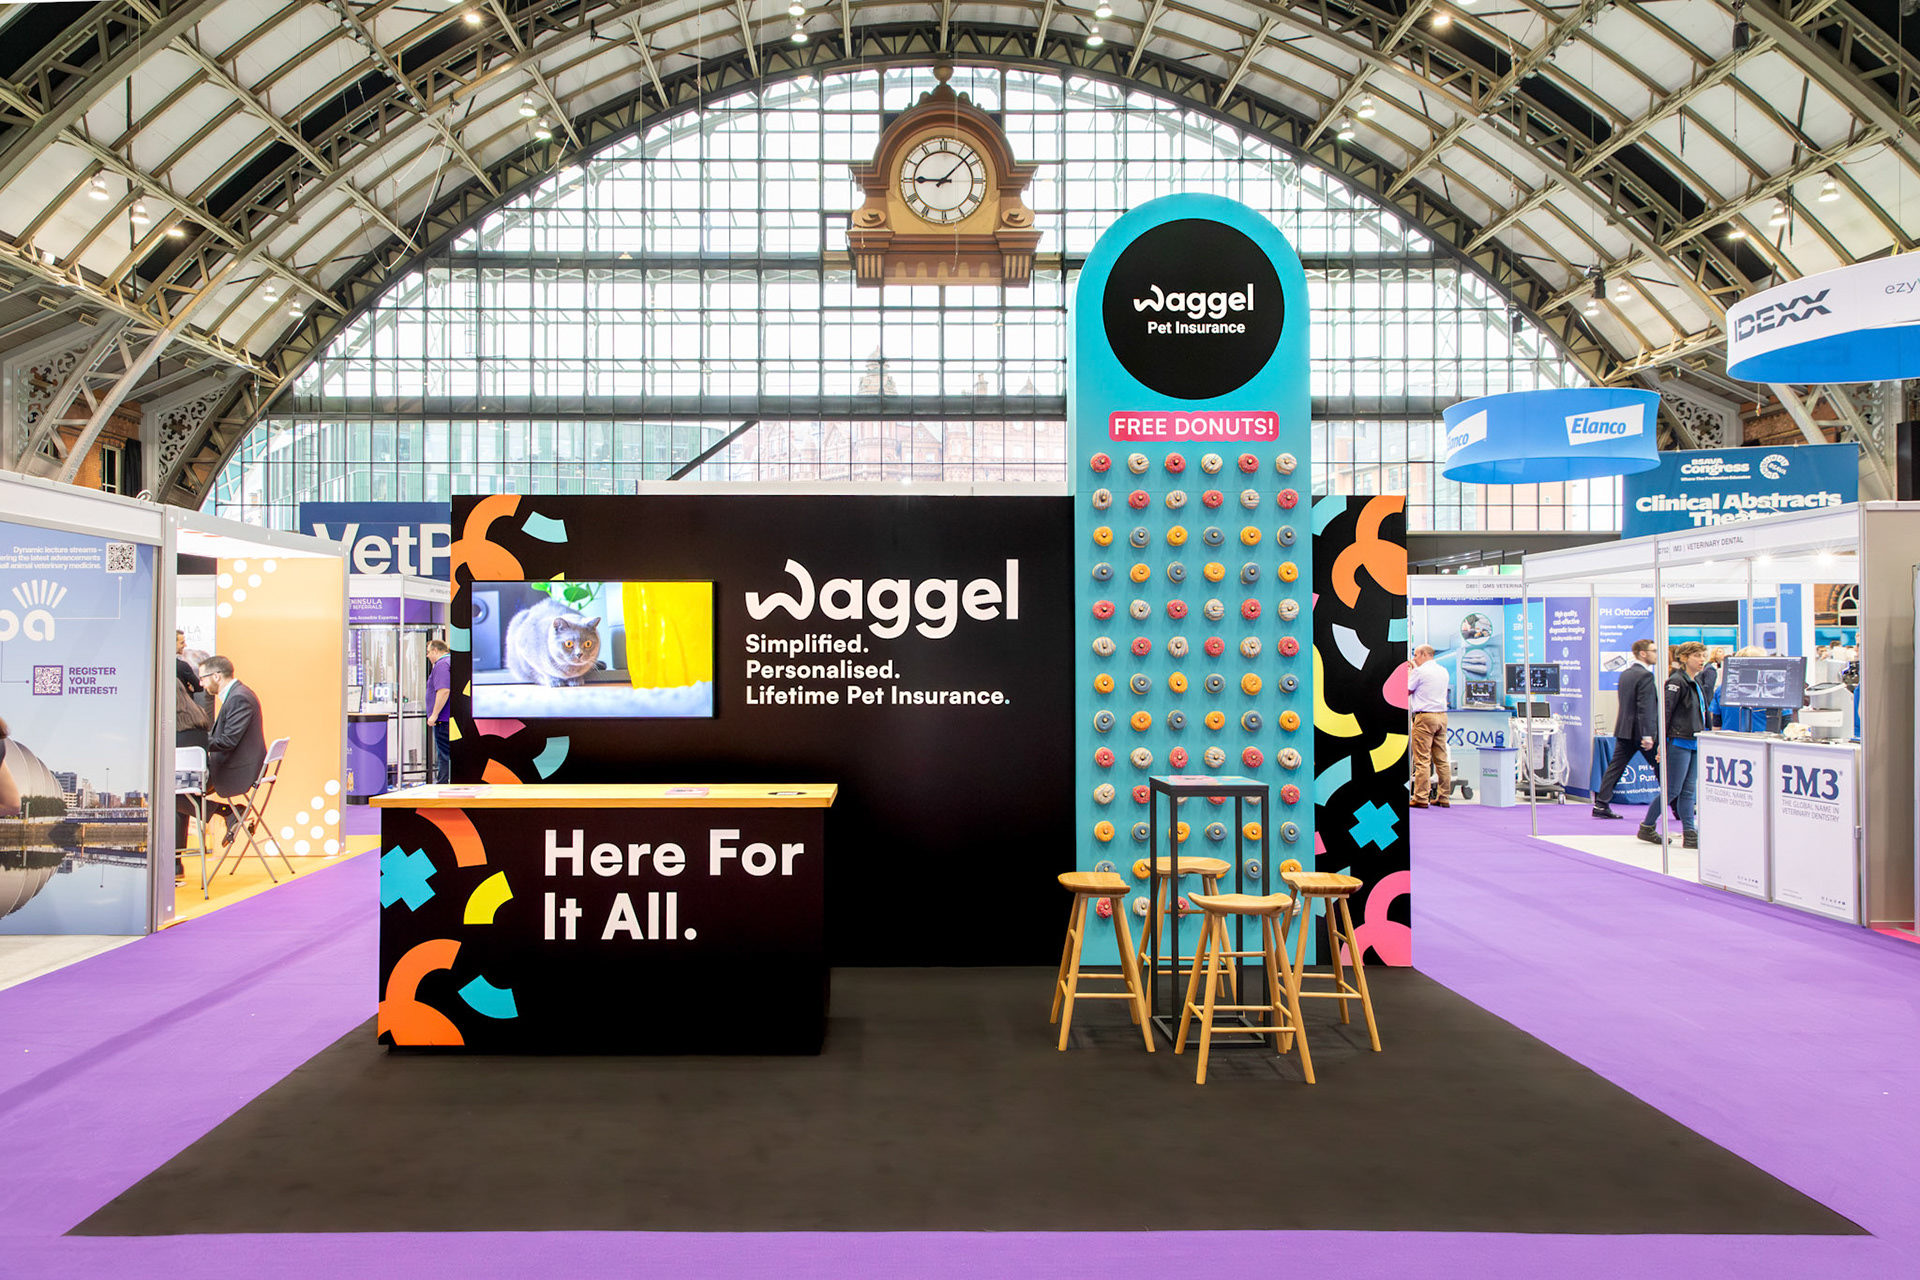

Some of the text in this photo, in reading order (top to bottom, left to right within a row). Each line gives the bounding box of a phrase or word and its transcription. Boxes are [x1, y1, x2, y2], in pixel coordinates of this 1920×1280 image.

[1133, 283, 1255, 320] Waggel
[1733, 288, 1833, 343] IDEXX
[1147, 320, 1245, 334] Pet Insurance
[1114, 418, 1274, 435] FREE DONUTS!
[1571, 417, 1627, 435] Elanco
[1680, 463, 1750, 476] Congress
[1635, 491, 1842, 512] Clinical Abstracts
[13, 546, 43, 554] Dynamic
[1687, 539, 1720, 550] VETERINARY
[1721, 536, 1744, 546] DENTAL
[34, 562, 67, 570] veterinary
[745, 558, 1019, 640] Waggel
[1599, 608, 1612, 616] PH
[745, 633, 869, 658] Simplified.
[69, 667, 116, 675] REGISTER
[746, 659, 900, 679] Personalised.
[69, 677, 96, 685] YOUR
[68, 687, 118, 695] INTEREST!
[746, 685, 1011, 705] Lifetime Pet Insurance.
[1705, 755, 1753, 788] iM3
[1781, 764, 1840, 800] iM3
[1705, 787, 1713, 795] THE
[1714, 789, 1731, 797] GLOBAL
[1705, 794, 1753, 808] VETERINARY DENTISTRY
[1782, 799, 1840, 814] THE GLOBAL NAME IN
[1782, 807, 1840, 823] VETERINARY DENTISTRY
[544, 829, 804, 876] Here For
[544, 892, 698, 940] It All.
